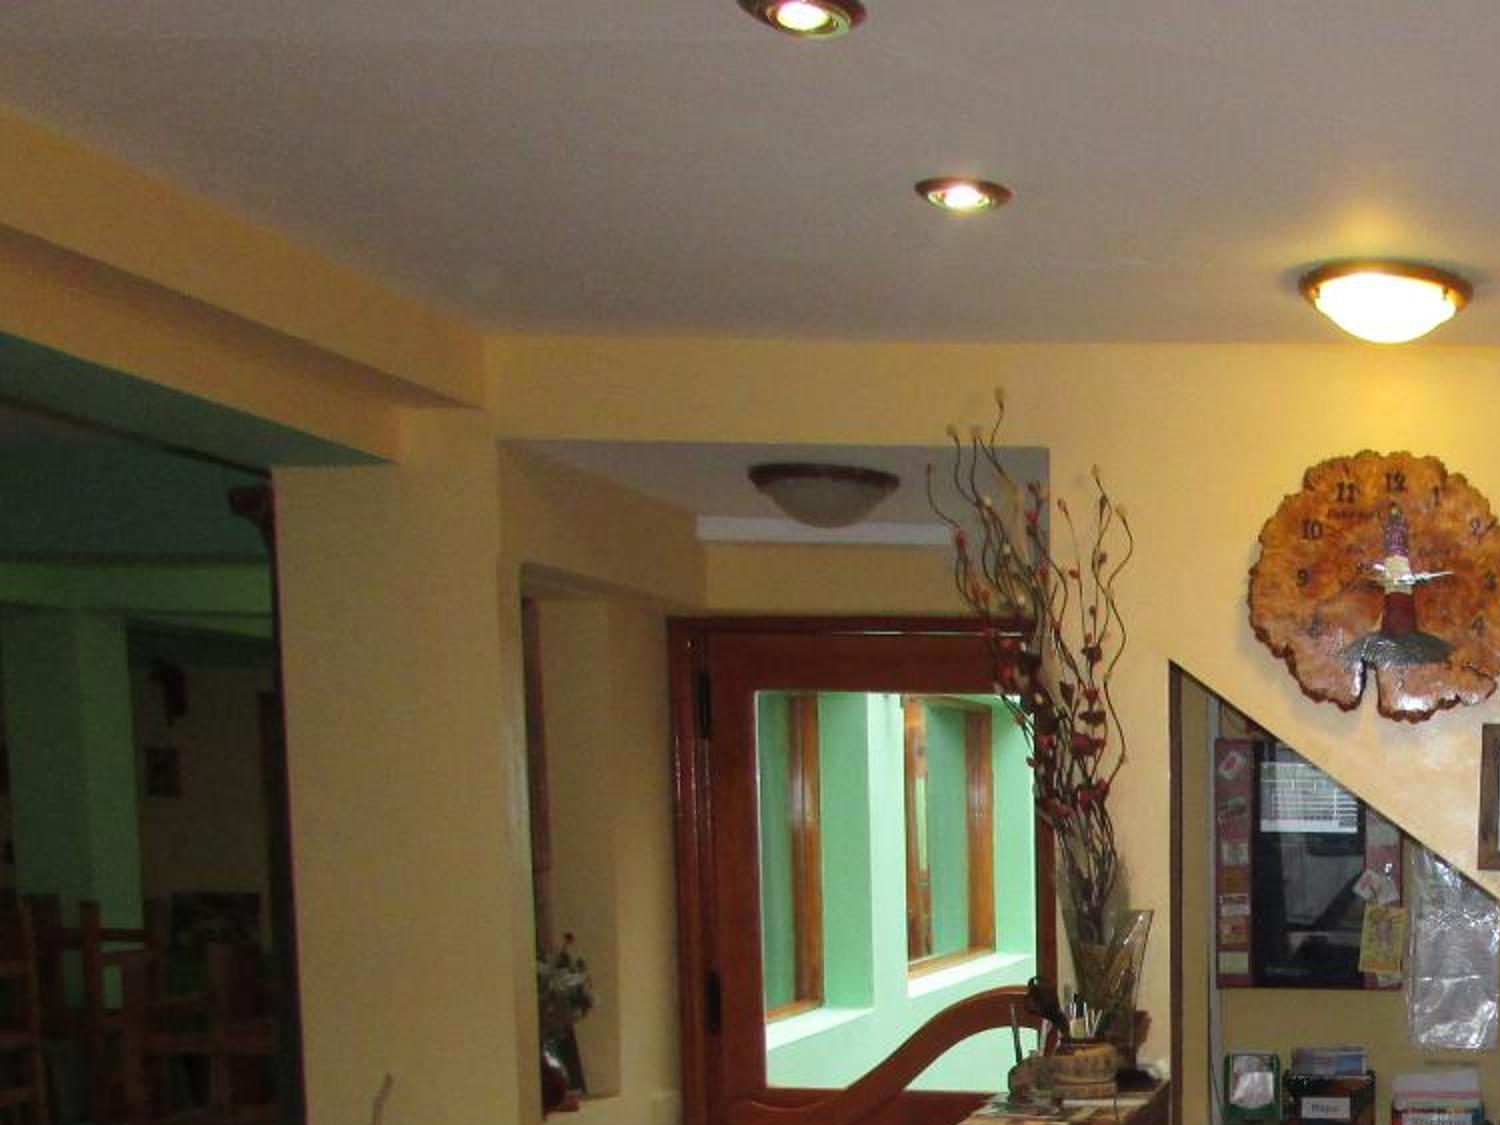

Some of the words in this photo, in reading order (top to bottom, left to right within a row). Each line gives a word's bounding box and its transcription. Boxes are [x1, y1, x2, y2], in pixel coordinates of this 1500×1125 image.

[1385, 471, 1407, 493] 12
[1336, 482, 1356, 505] 11
[1303, 518, 1324, 541] 10
[1296, 568, 1311, 588] 9
